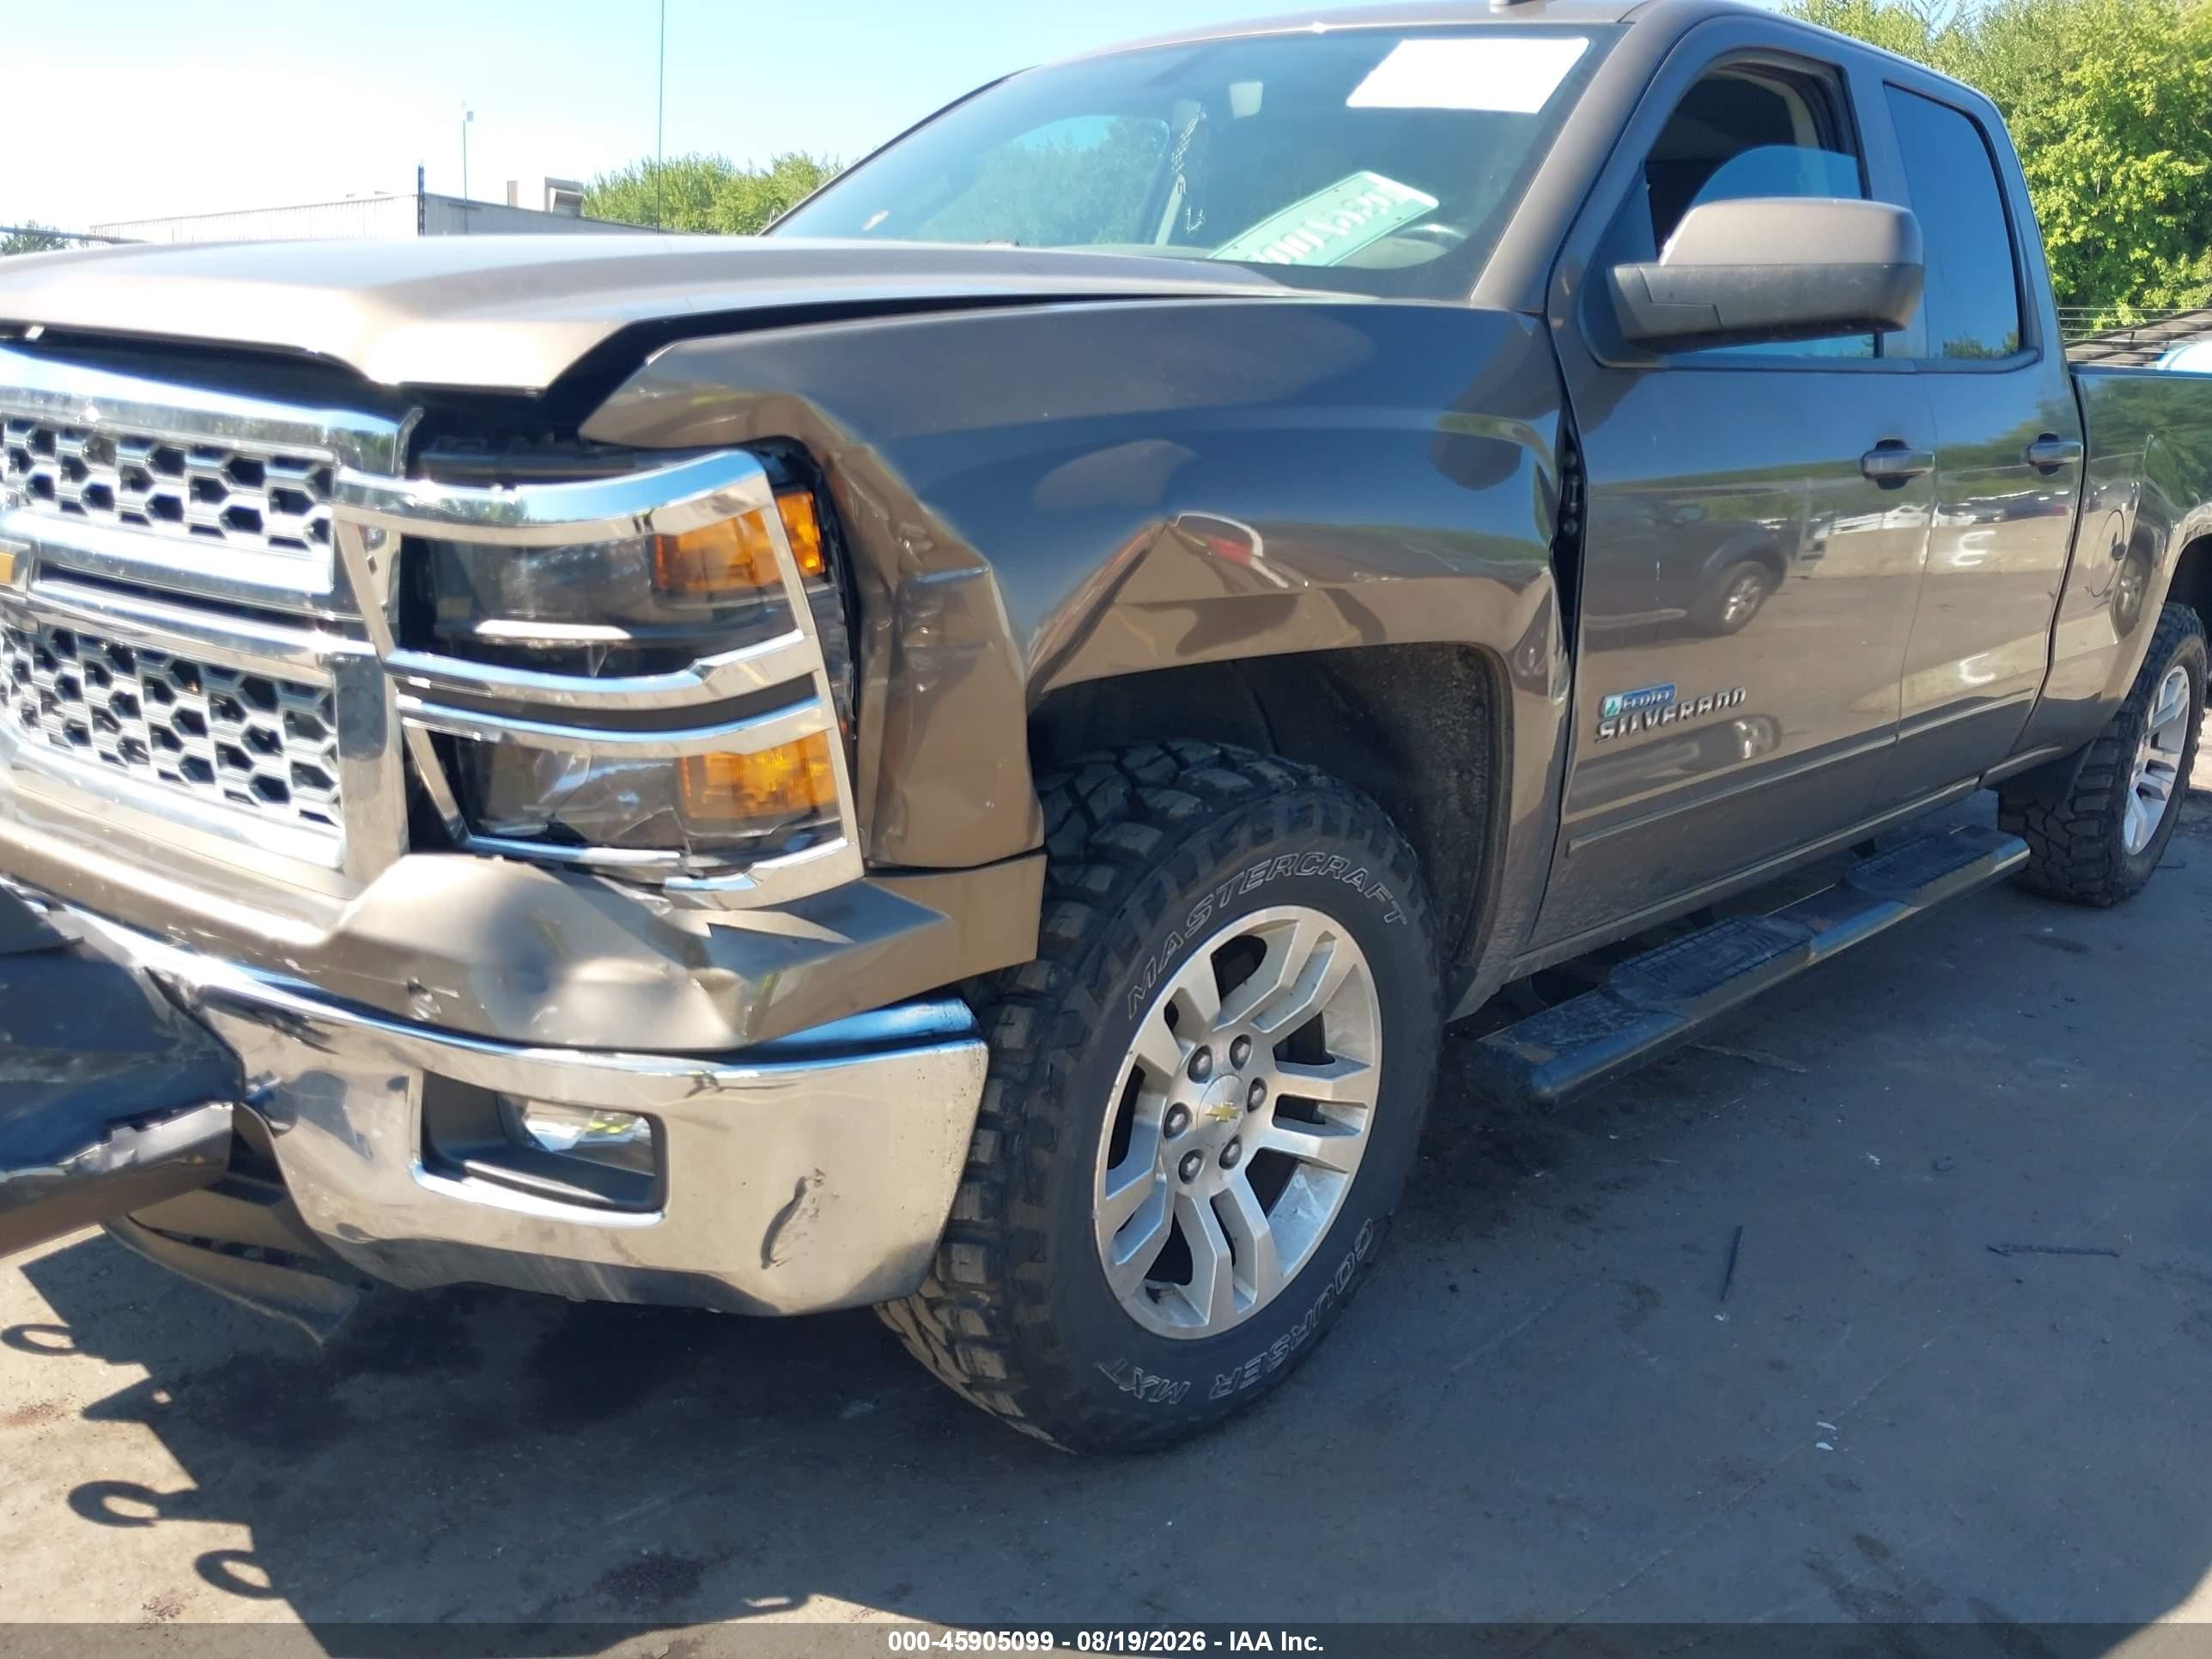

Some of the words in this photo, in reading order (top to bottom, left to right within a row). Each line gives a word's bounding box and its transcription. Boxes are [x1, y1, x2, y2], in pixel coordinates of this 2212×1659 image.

[1595, 686, 1747, 744] SILVERADO
[1127, 851, 1408, 1020] MASTERCRAFT
[1208, 1217, 1374, 1401] COURSER
[1096, 1358, 1208, 1405] MXT
